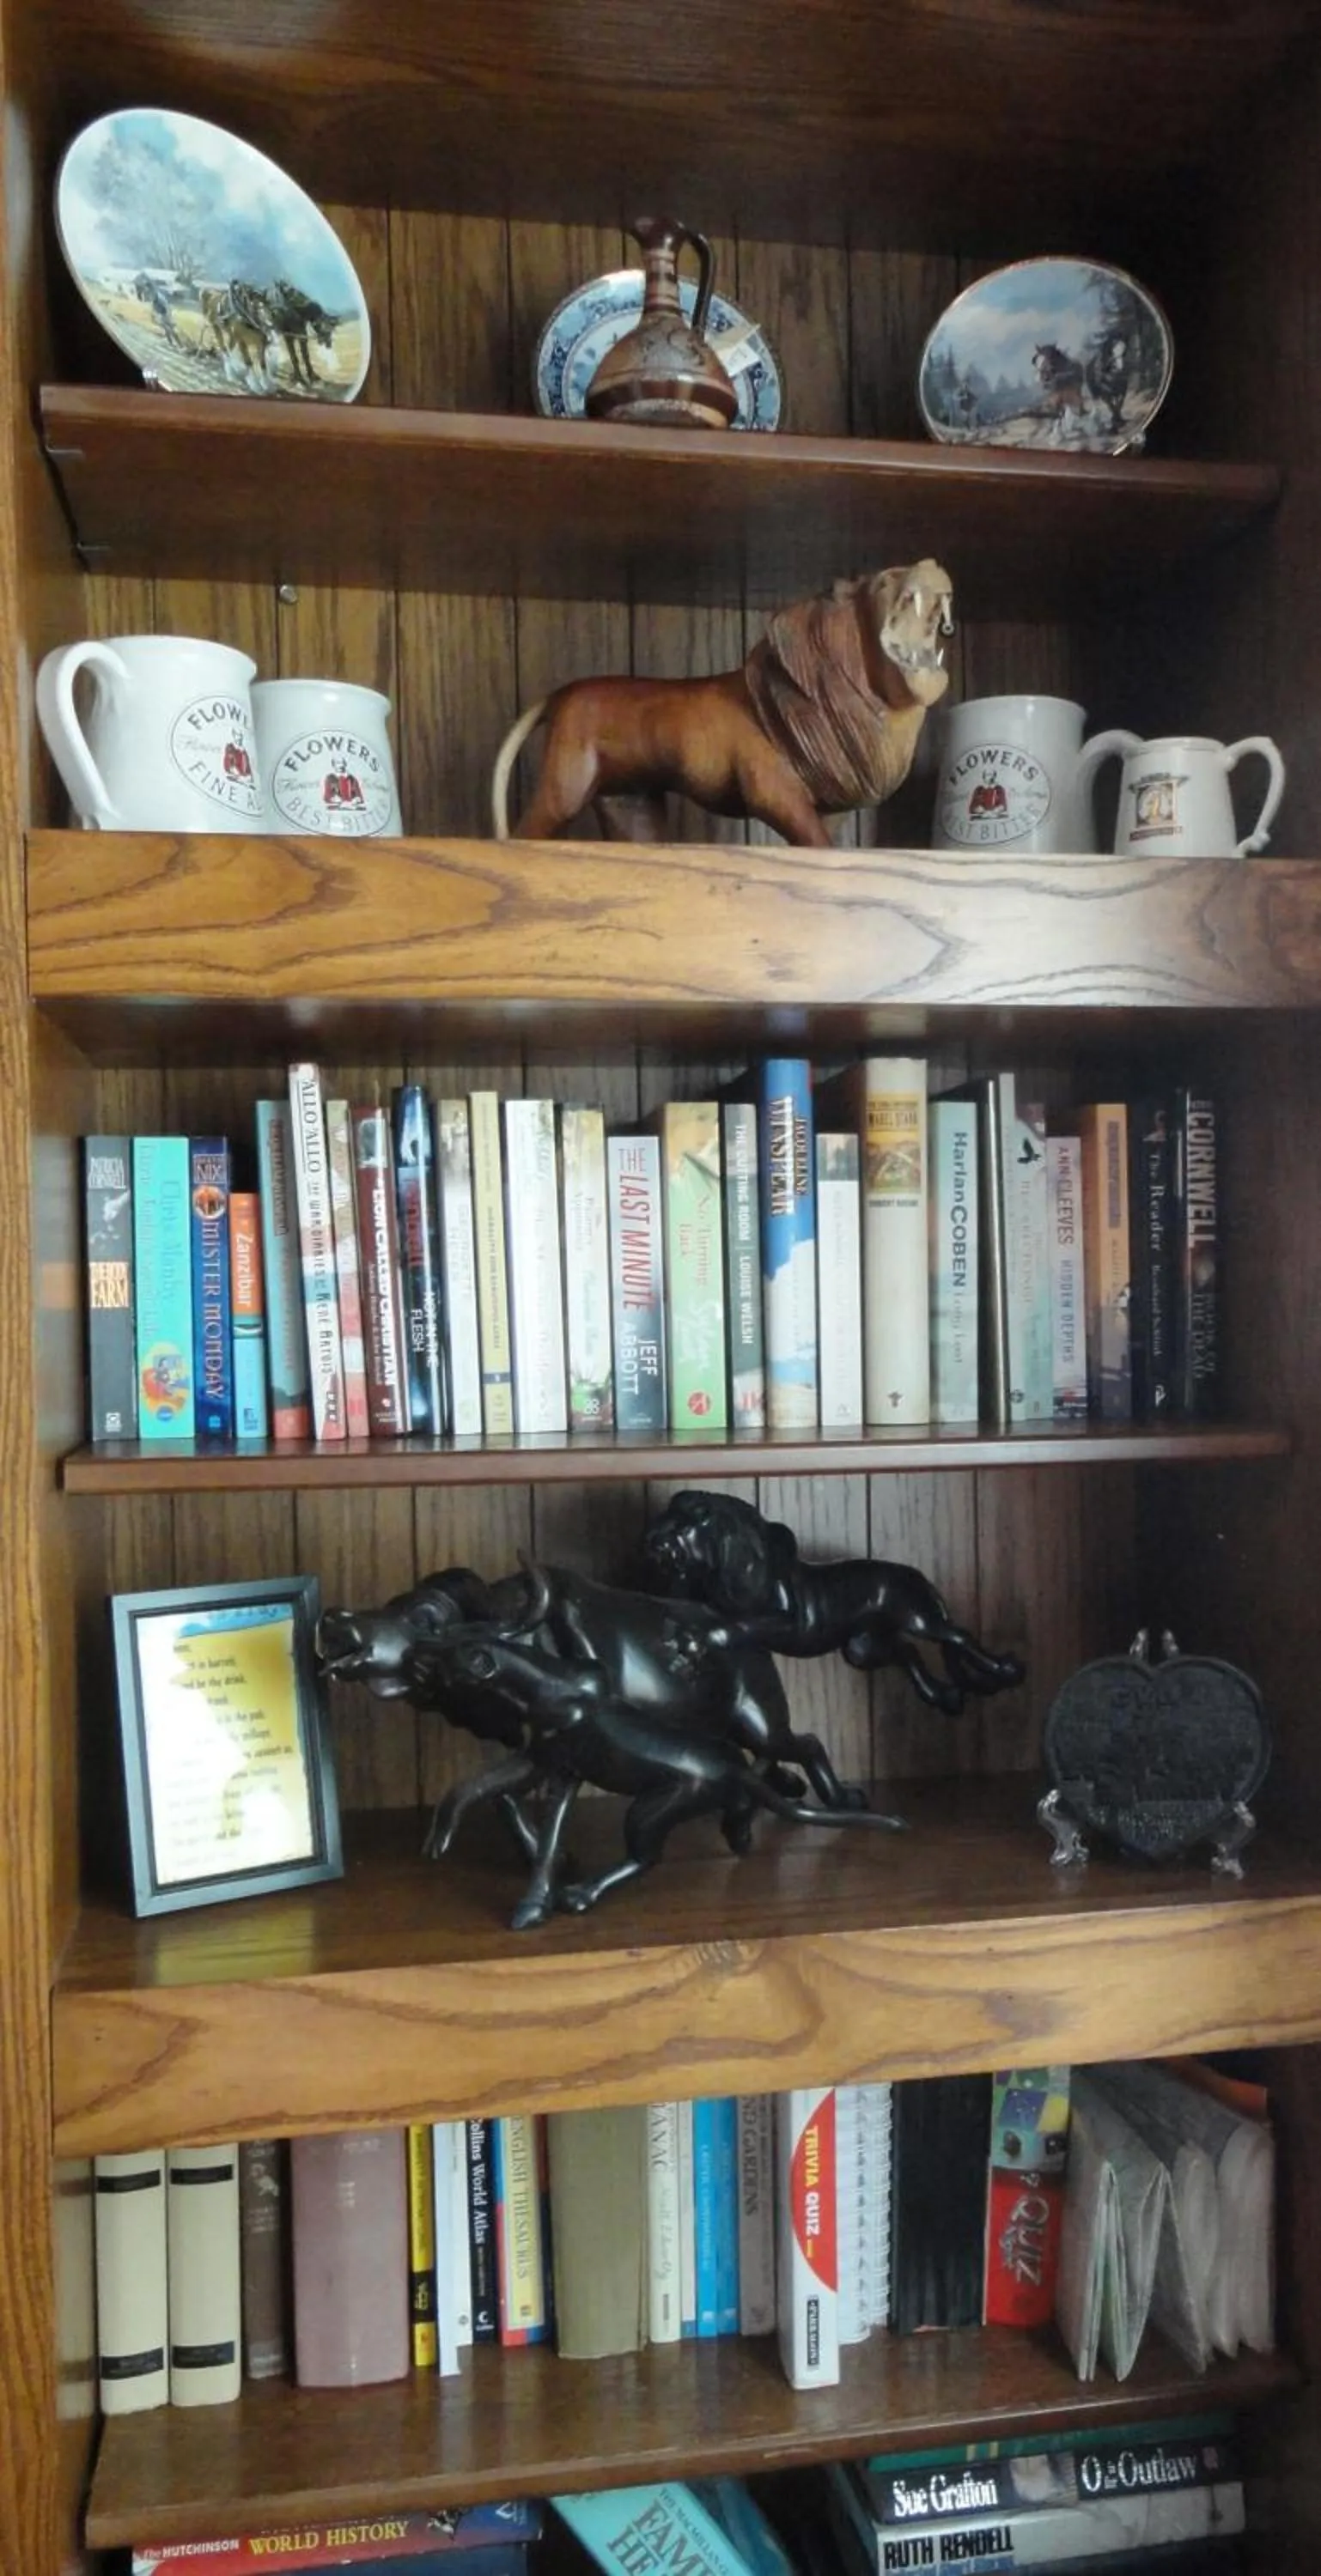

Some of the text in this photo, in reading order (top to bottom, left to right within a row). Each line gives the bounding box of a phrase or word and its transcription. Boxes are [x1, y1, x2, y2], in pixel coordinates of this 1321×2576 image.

[284, 735, 380, 773] FLOWERS
[949, 749, 1040, 787] FLOWERS
[188, 761, 238, 804] FINE
[735, 1124, 748, 1147] THE
[770, 1096, 795, 1218] WINSPEAR
[794, 1115, 811, 1195] JACQUELINE
[618, 1148, 648, 1172] THE
[1148, 1152, 1162, 1180] The
[1187, 1111, 1217, 1249] CORNWELL
[739, 1206, 752, 1242] ROOM
[950, 1132, 968, 1288] Harlan COBEN
[1149, 1183, 1167, 1252] Reader
[620, 1174, 655, 1310] LAST MINUTE
[1056, 1145, 1074, 1365] ANN CLEEVES HIDDEN DEPTHS
[235, 1231, 256, 1308] Zanzibar
[740, 1255, 753, 1298] LOUISE
[201, 1221, 225, 1399] MISTER MONDAY
[411, 1309, 426, 1352] FLESH
[741, 1302, 755, 1345] WELSH
[620, 1321, 639, 1395] ABBOTT
[638, 1340, 658, 1376] JEFF
[472, 2163, 488, 2206] World
[741, 2129, 760, 2217] GARDENS
[804, 2125, 821, 2236] TRIVIA QUIZ
[473, 2208, 490, 2244] Atlas
[514, 2190, 534, 2281] THESAURUS
[1011, 2194, 1050, 2287] QUIZ
[1081, 2455, 1103, 2493] O
[1117, 2446, 1197, 2488] Outlaw
[892, 2470, 999, 2518] Sue Grafton
[162, 2538, 240, 2559] HUTCHINSON
[248, 2530, 320, 2556] WORLD
[326, 2520, 410, 2548] HISTORY
[606, 2522, 664, 2576] HE
[883, 2524, 1015, 2570] RUTH RENDELL
